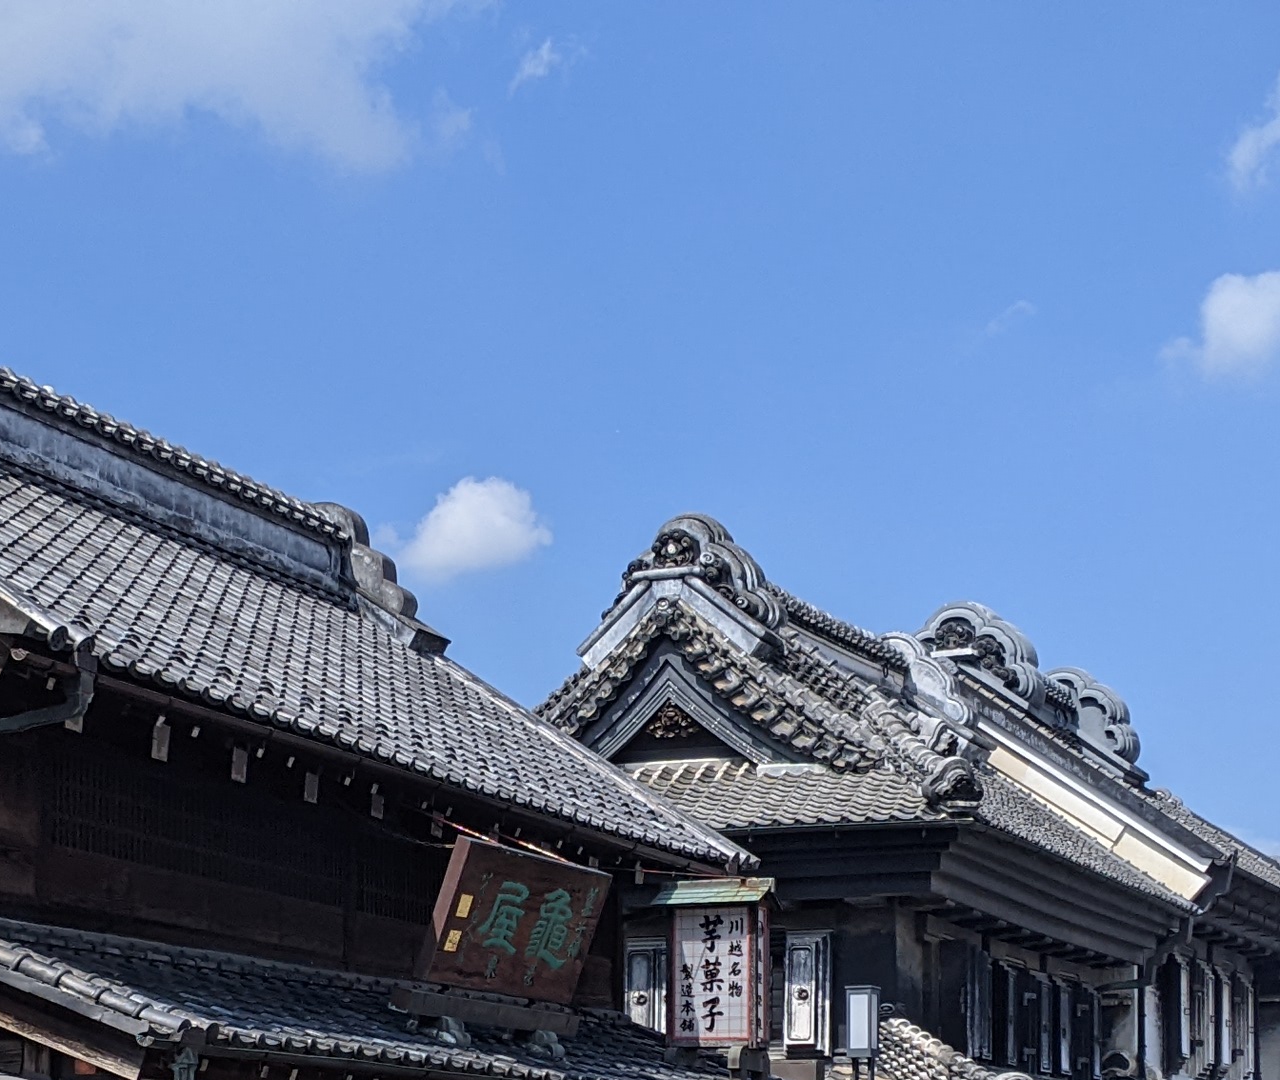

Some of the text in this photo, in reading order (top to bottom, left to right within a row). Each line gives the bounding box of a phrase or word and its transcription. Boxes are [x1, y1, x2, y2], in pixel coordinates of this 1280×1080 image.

[699, 914, 725, 1033] 芋菓子
[728, 917, 744, 998] 川越名物
